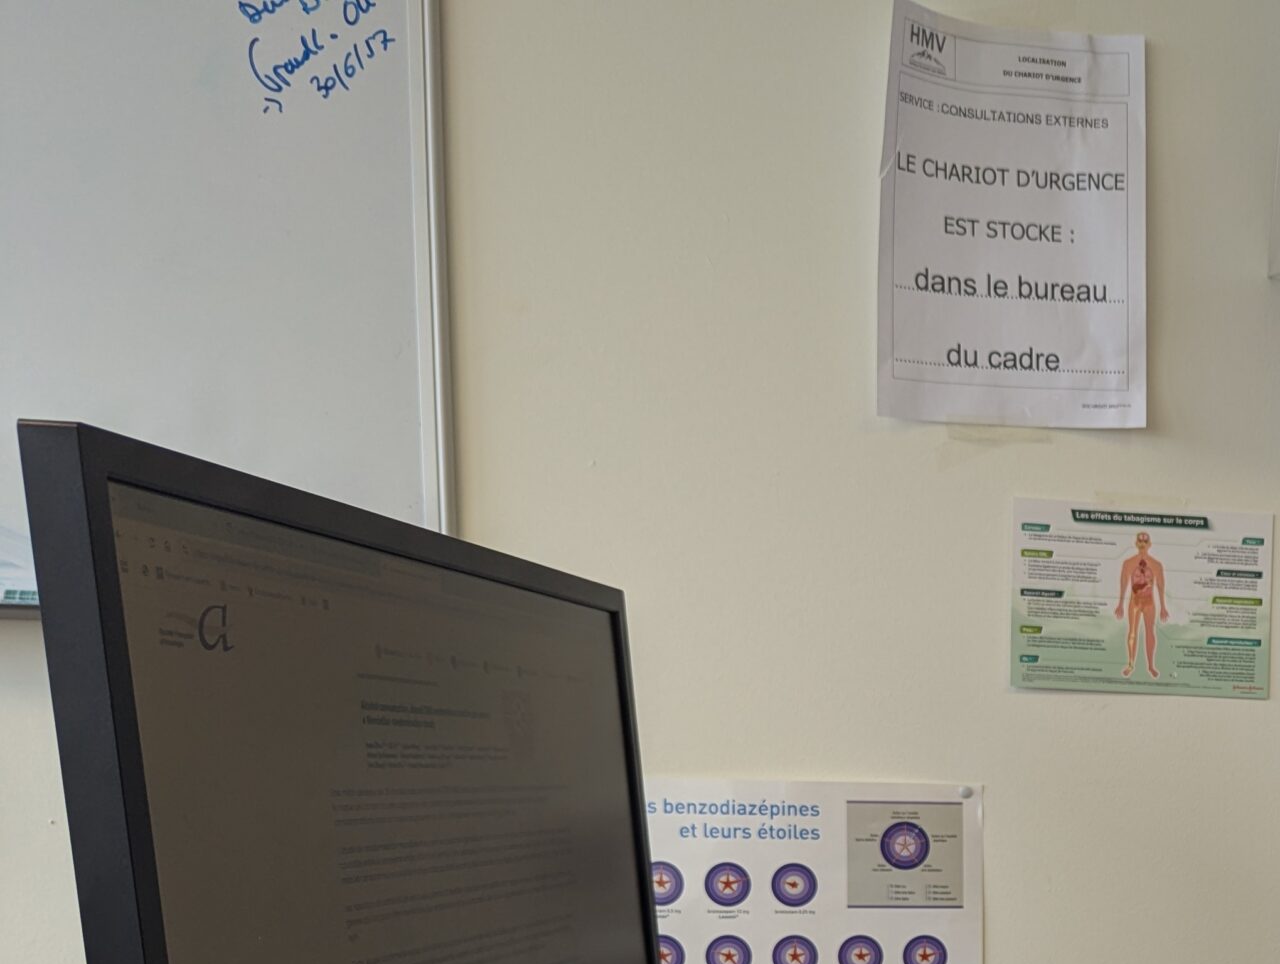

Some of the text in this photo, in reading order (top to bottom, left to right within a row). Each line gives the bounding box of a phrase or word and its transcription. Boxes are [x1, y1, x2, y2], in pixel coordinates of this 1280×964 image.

[910, 23, 946, 53] HMV
[1002, 69, 1013, 78] DU
[1014, 70, 1044, 80] CHARIOT
[899, 91, 934, 112] SERVICE
[1045, 115, 1109, 130] EXTERNES
[897, 151, 1126, 192] LE CHARIOT D'URGENCE
[943, 216, 980, 238] EST
[986, 221, 1062, 244] STOCKE
[914, 267, 1108, 304] dans le bureau
[946, 344, 1061, 372] du cadre
[1124, 514, 1161, 525] tabagisme
[1184, 518, 1204, 526] corps
[663, 798, 821, 820] benzodiazépines
[679, 823, 821, 841] et leurs étoiles
